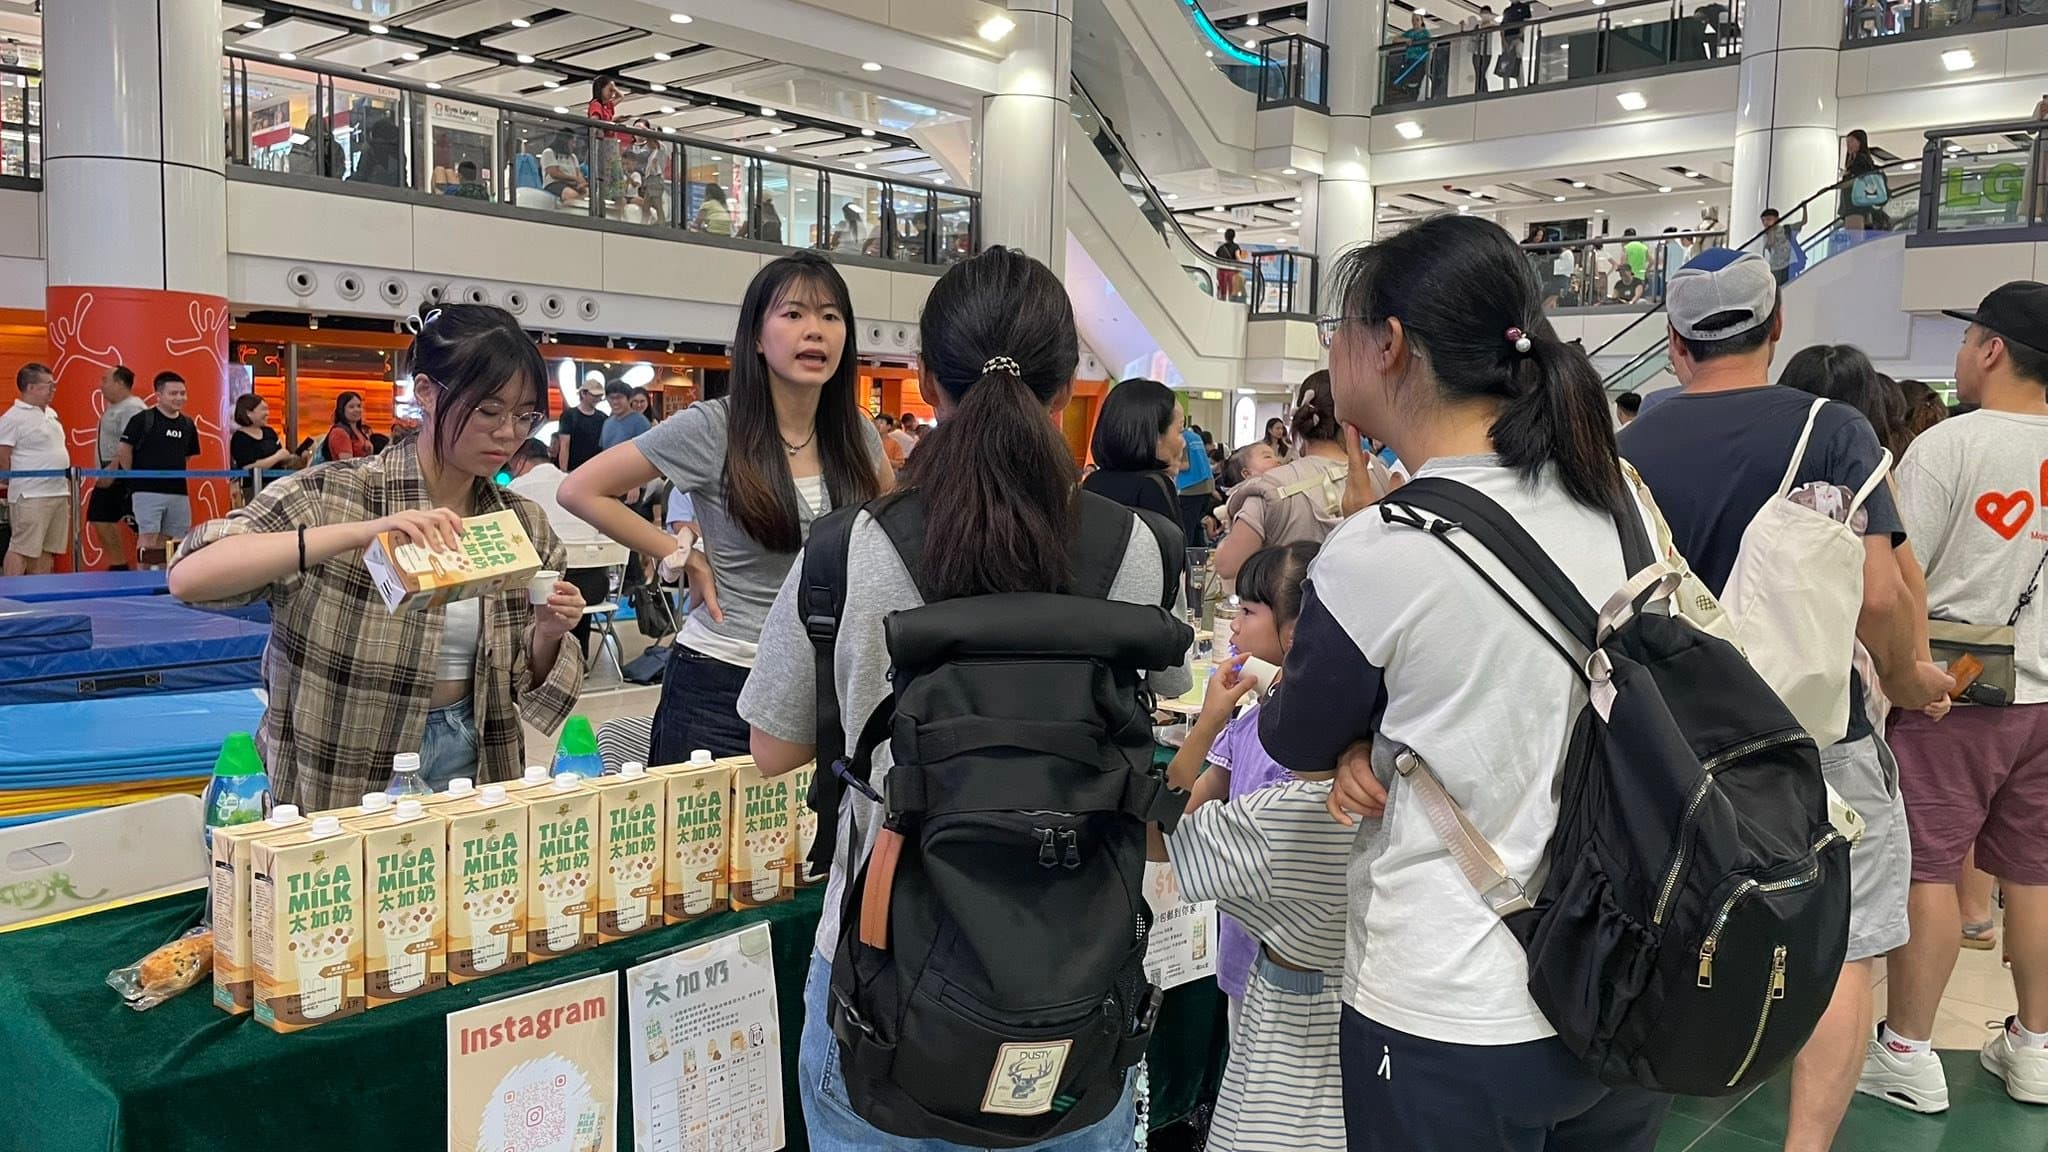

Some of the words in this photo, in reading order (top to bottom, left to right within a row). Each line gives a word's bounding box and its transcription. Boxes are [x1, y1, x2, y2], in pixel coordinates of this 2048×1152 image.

[1946, 163, 2024, 208] LG
[470, 525, 505, 568] MILK
[486, 520, 518, 565] TIGA
[677, 790, 721, 810] TIGA
[745, 782, 788, 802] TIGA
[610, 802, 656, 826] TIGA
[677, 806, 721, 829] MILK
[745, 797, 788, 818] MILK
[539, 817, 589, 842] TIGA
[610, 819, 656, 843] MILK
[677, 822, 722, 845] 太加奶
[745, 815, 788, 835] 太加奶
[463, 832, 518, 858] TIGA
[539, 834, 589, 859] MILK
[610, 837, 656, 861] 太加奶
[377, 847, 435, 874] TIGA
[463, 849, 518, 876] MILK
[539, 853, 589, 877] 太加奶
[287, 864, 351, 893] TIGA
[378, 865, 435, 894] MILK
[464, 868, 518, 895] 太加奶
[288, 884, 352, 914] MILK
[378, 885, 435, 914] 太加奶
[289, 904, 353, 935] 太加奶
[645, 959, 730, 1008] 太加奶
[460, 996, 606, 1055] Instagram
[1020, 1051, 1051, 1060] DUSTY
